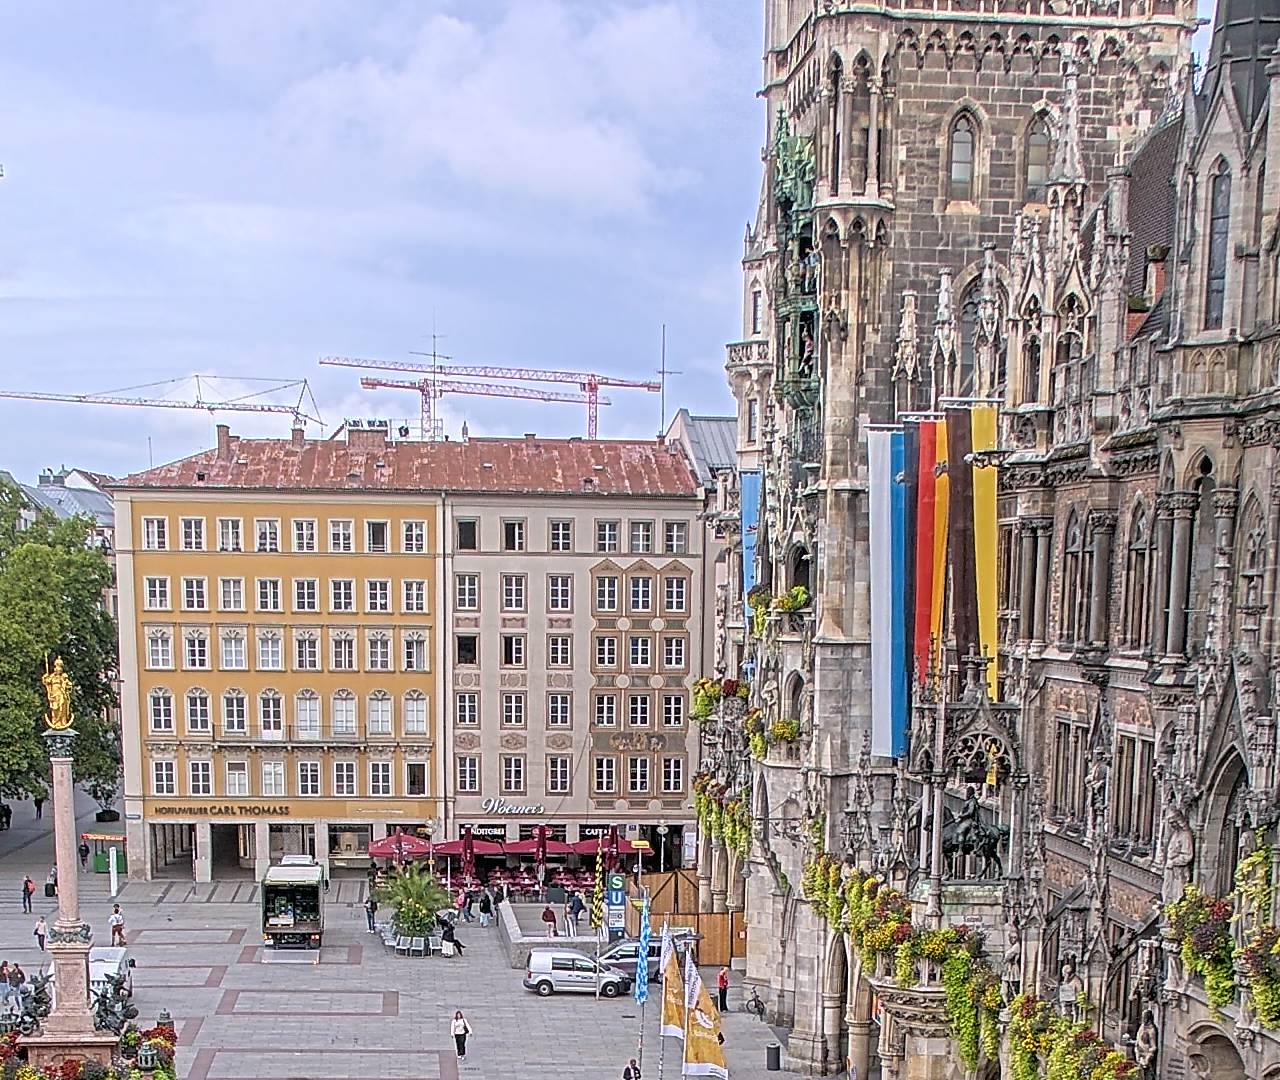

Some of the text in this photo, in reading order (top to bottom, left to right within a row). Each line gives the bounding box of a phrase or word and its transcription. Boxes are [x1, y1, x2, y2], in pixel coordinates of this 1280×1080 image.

[210, 806, 236, 815] CARL
[238, 806, 290, 815] THOMASS
[481, 797, 545, 815] Woerner's
[611, 876, 623, 889] S
[612, 891, 622, 904] U
